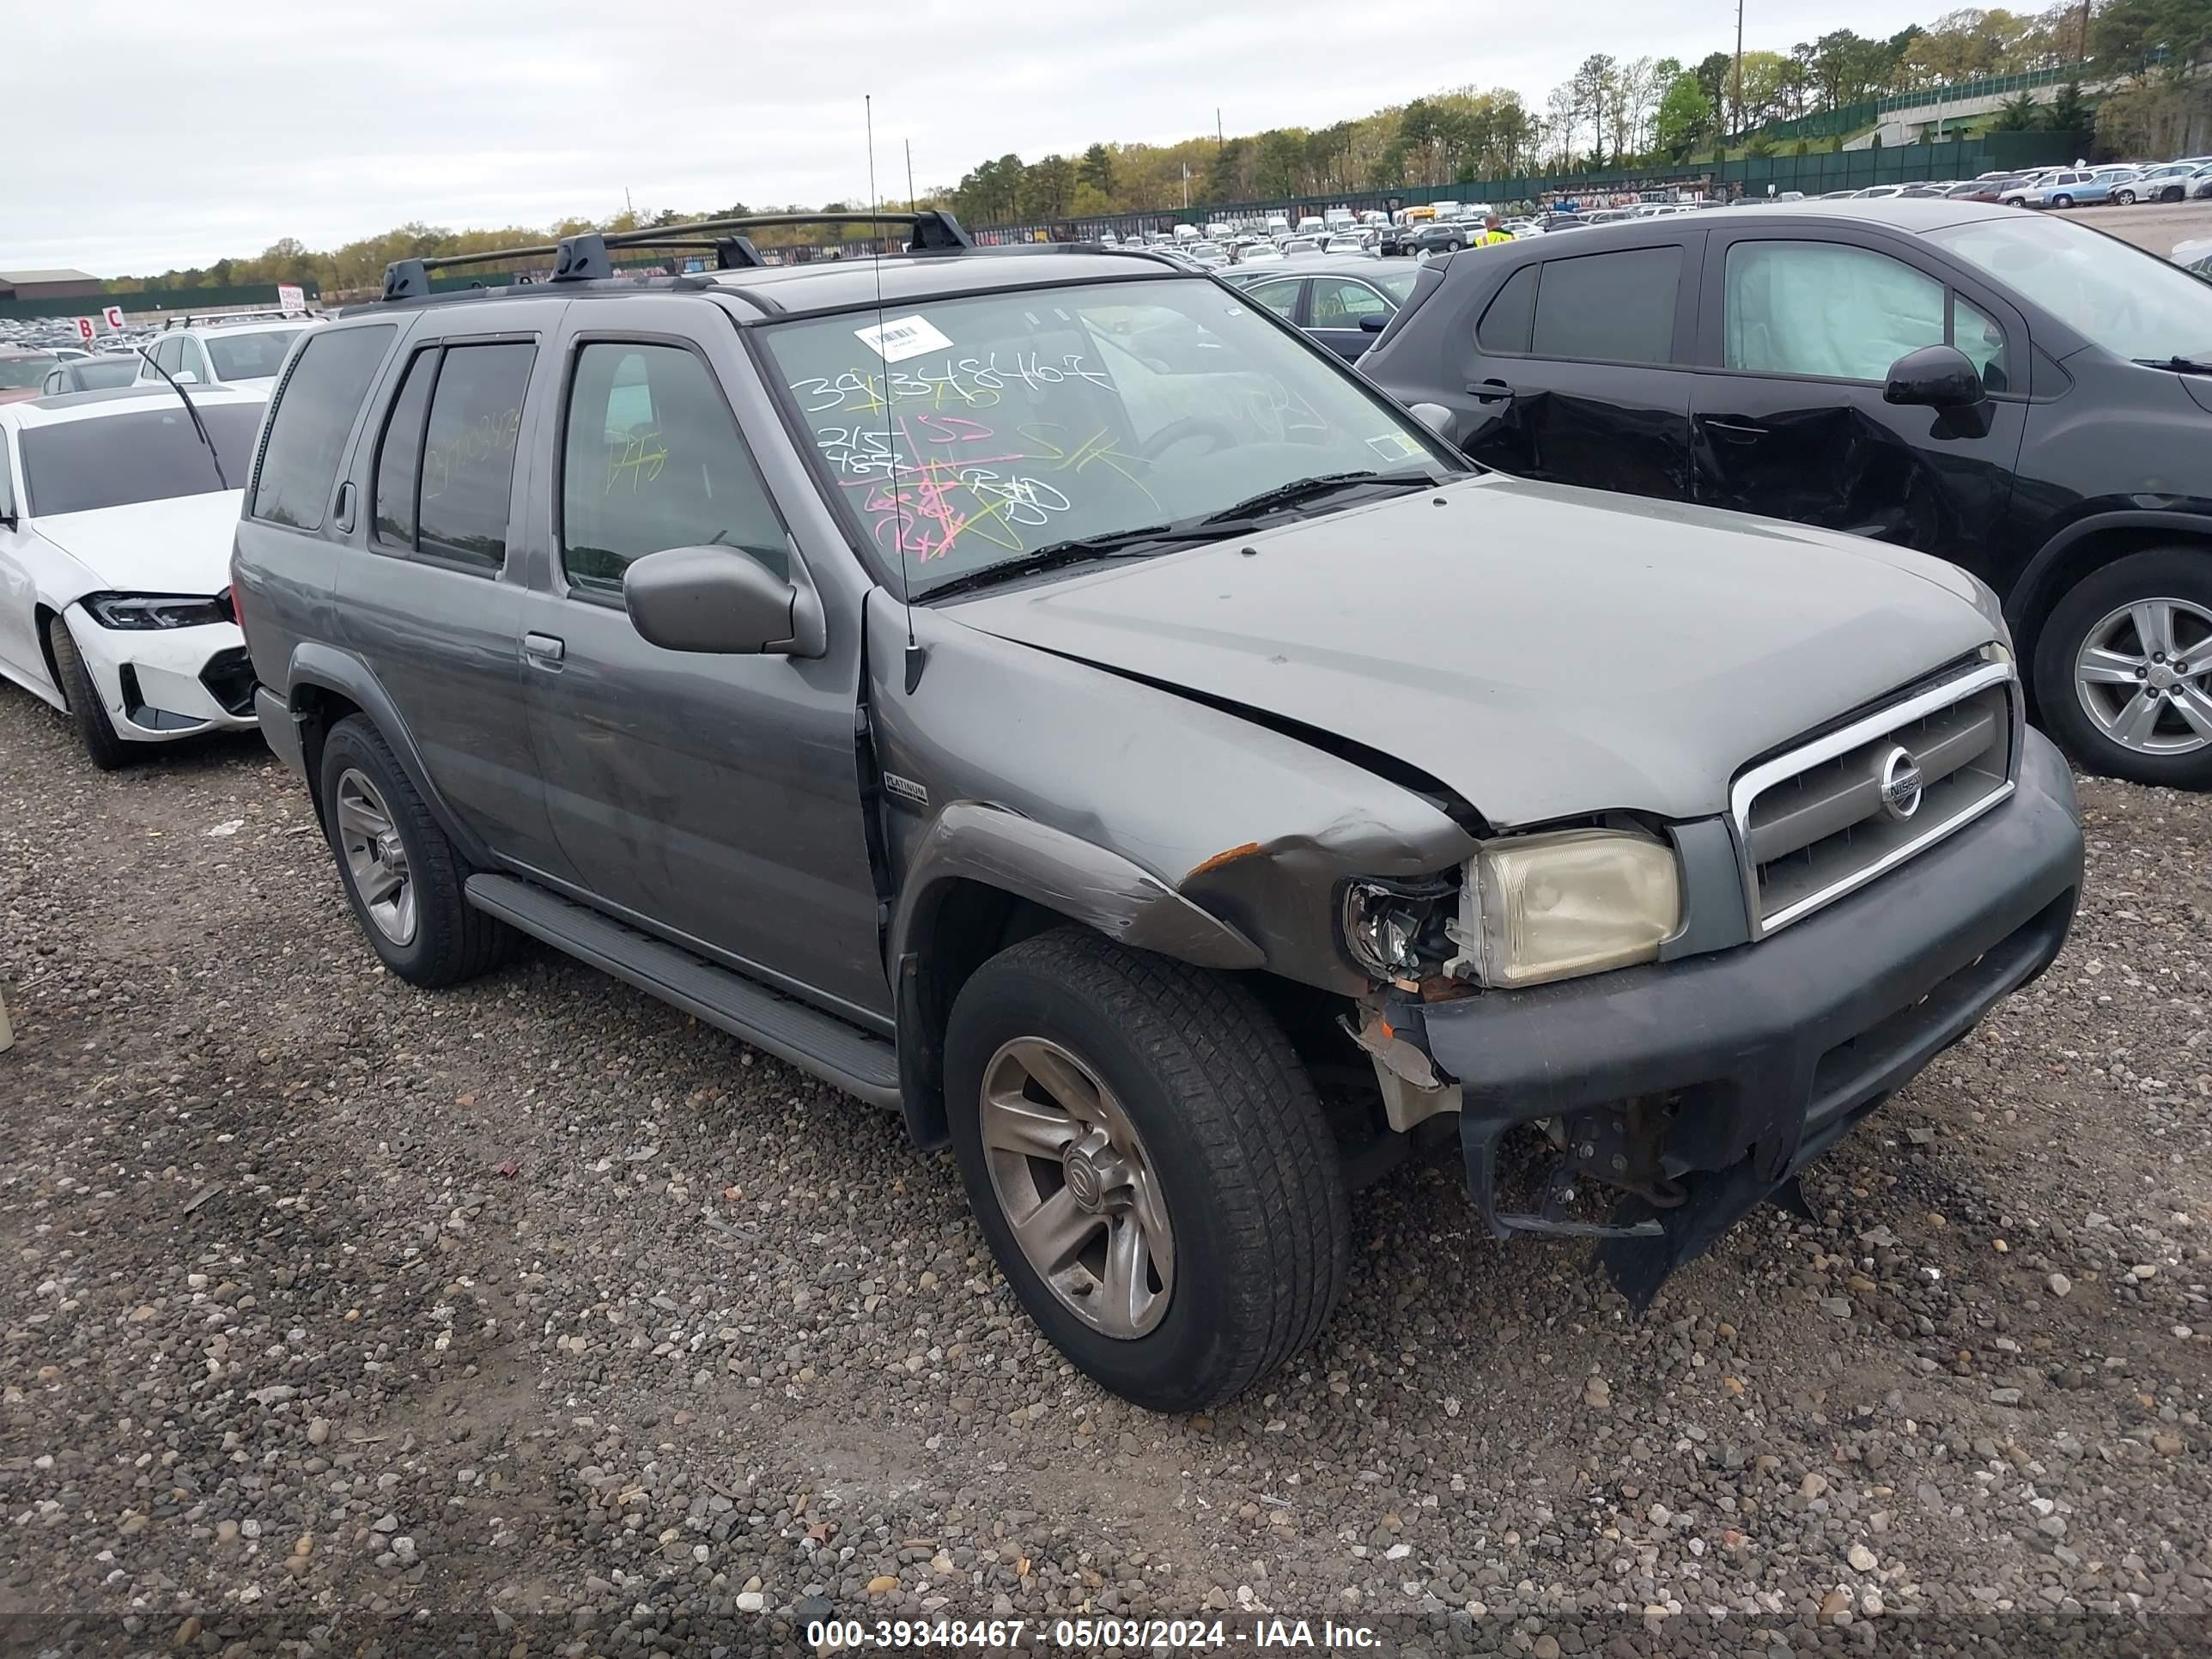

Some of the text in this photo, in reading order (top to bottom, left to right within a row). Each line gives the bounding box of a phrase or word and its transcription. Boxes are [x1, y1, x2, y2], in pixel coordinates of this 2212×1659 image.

[108, 309, 122, 327] C
[79, 319, 92, 337] B
[885, 775, 927, 799] PLATINUM
